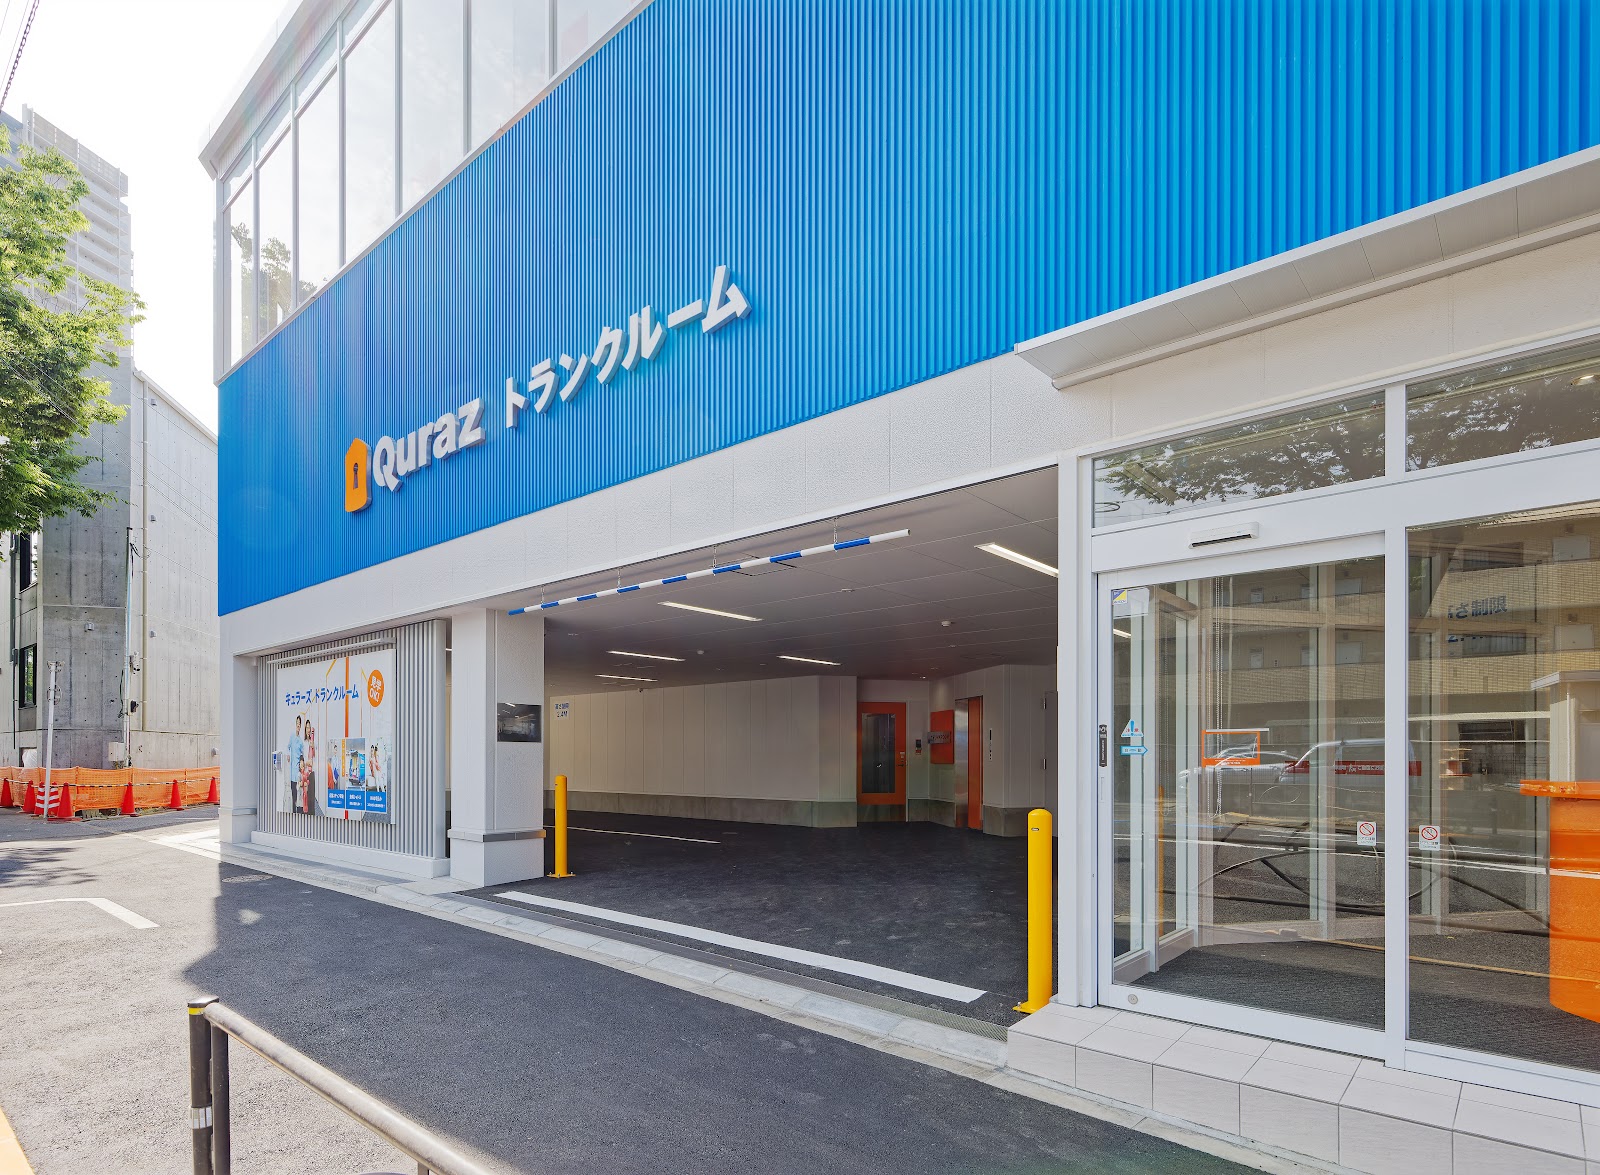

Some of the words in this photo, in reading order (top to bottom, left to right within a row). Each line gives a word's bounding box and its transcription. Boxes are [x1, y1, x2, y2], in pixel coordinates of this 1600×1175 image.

[372, 397, 486, 492] Quraz
[505, 264, 752, 429] トランクルーム
[285, 689, 312, 706] キュラーズ
[315, 684, 359, 703] トランクルーム
